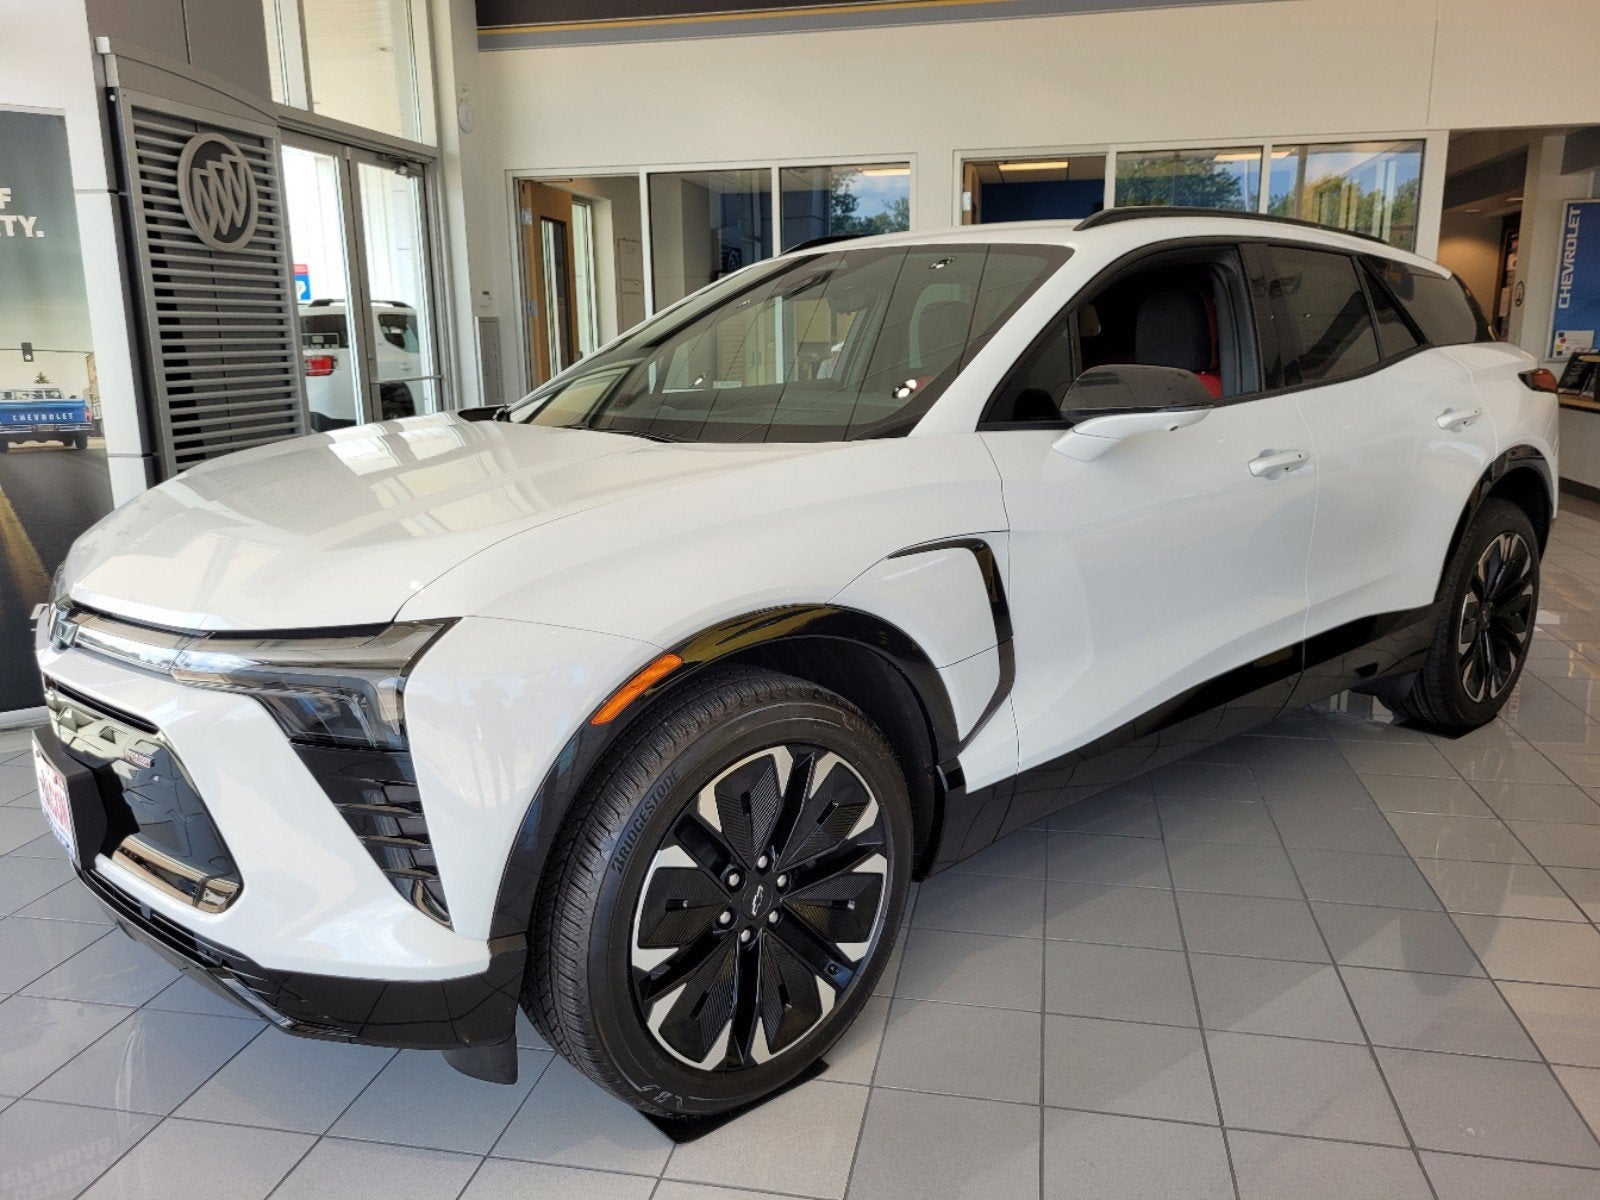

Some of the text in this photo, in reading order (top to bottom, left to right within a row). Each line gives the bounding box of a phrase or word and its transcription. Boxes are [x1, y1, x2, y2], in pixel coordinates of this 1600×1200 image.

[1557, 206, 1582, 309] CHEVROLET
[12, 412, 74, 421] CHEVROLET
[611, 767, 681, 874] BRIDGESTONE
